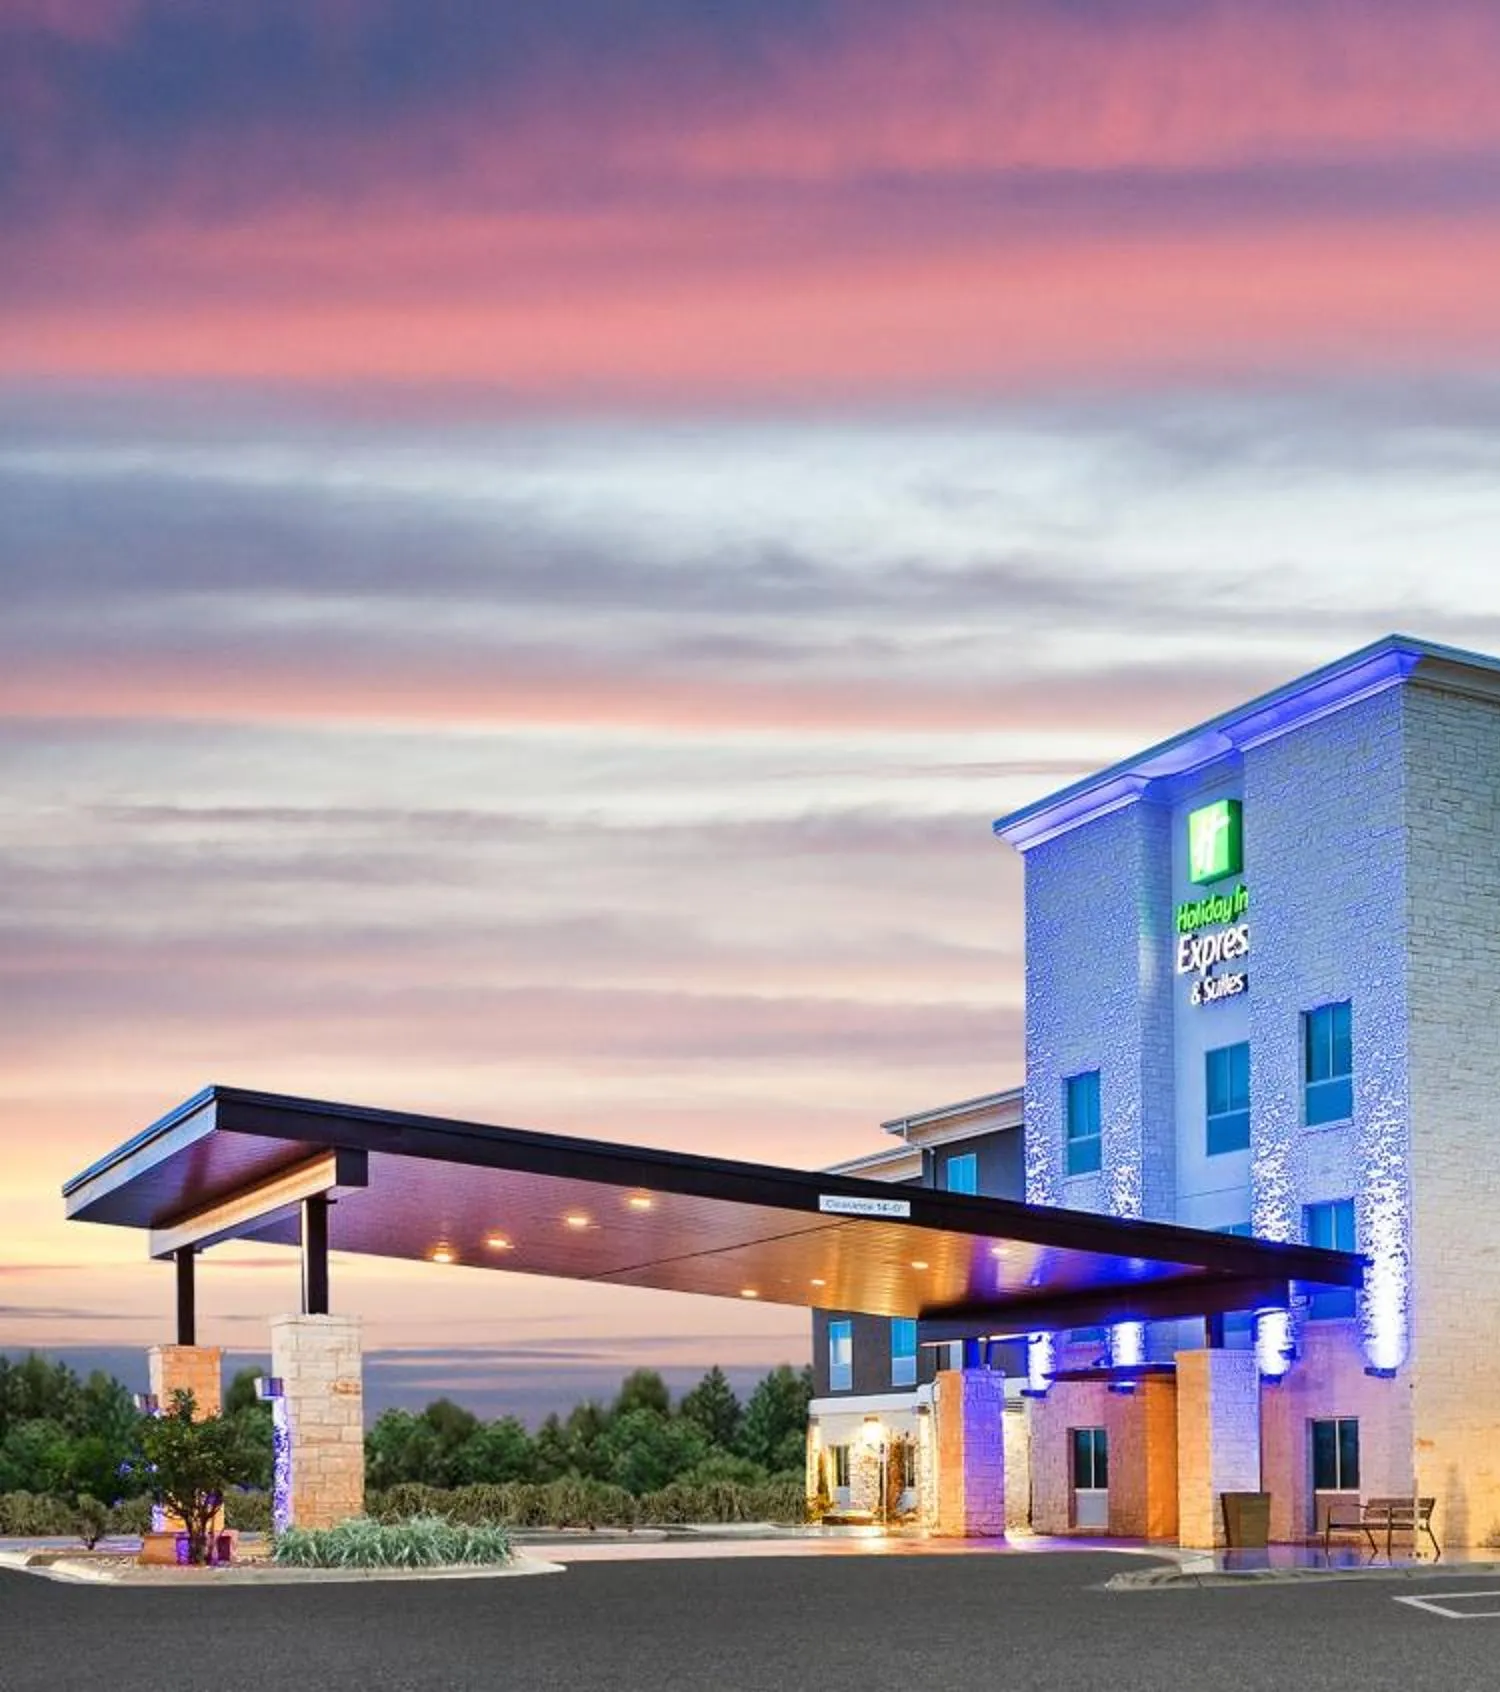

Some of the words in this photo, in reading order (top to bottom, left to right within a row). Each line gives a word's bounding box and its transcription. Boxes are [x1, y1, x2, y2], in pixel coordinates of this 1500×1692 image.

[1177, 891, 1233, 932] Holiday
[1234, 884, 1249, 913] In
[1178, 924, 1249, 975] Expres
[1202, 974, 1244, 1003] Suites
